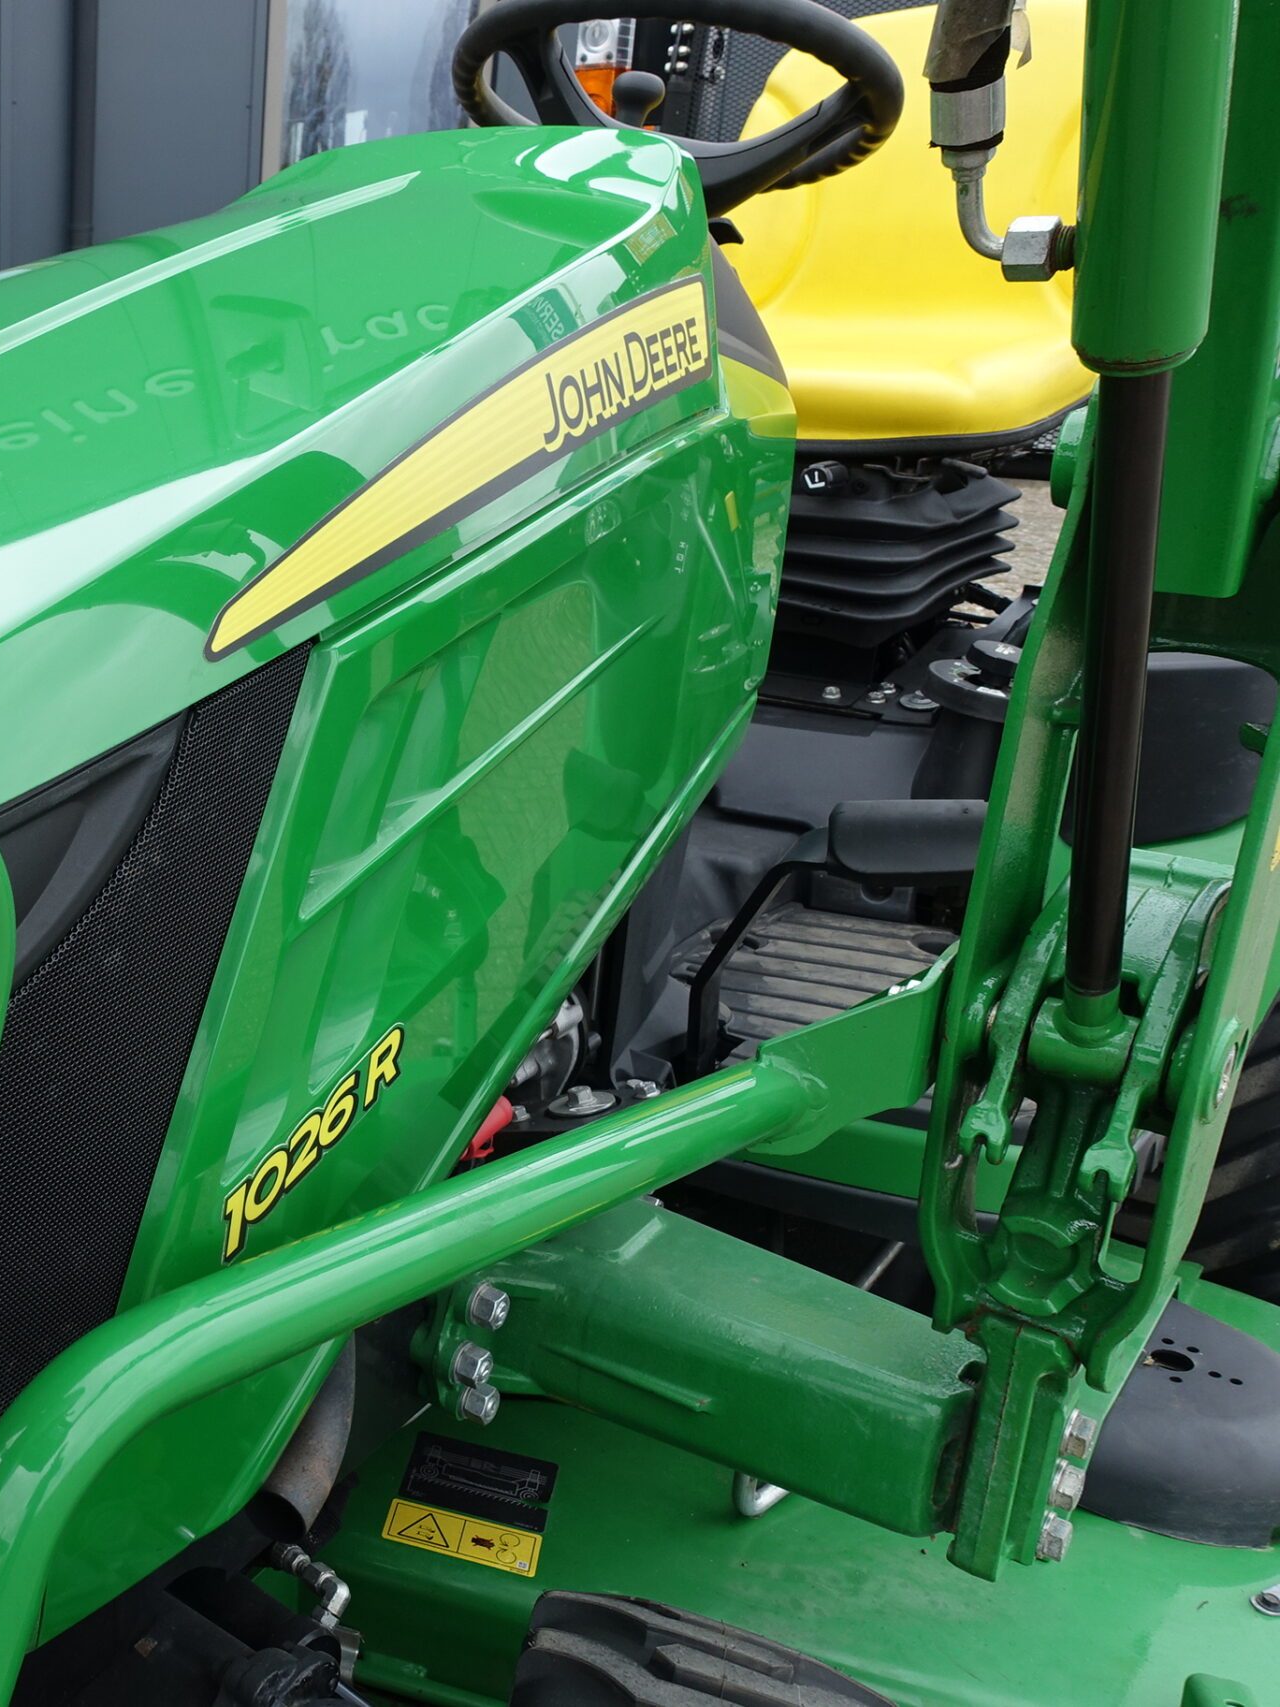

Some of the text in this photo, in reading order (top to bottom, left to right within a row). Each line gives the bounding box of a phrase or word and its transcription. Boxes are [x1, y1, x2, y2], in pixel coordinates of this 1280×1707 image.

[542, 317, 703, 447] JOHN DEERE
[223, 1026, 406, 1264] 1026 R
